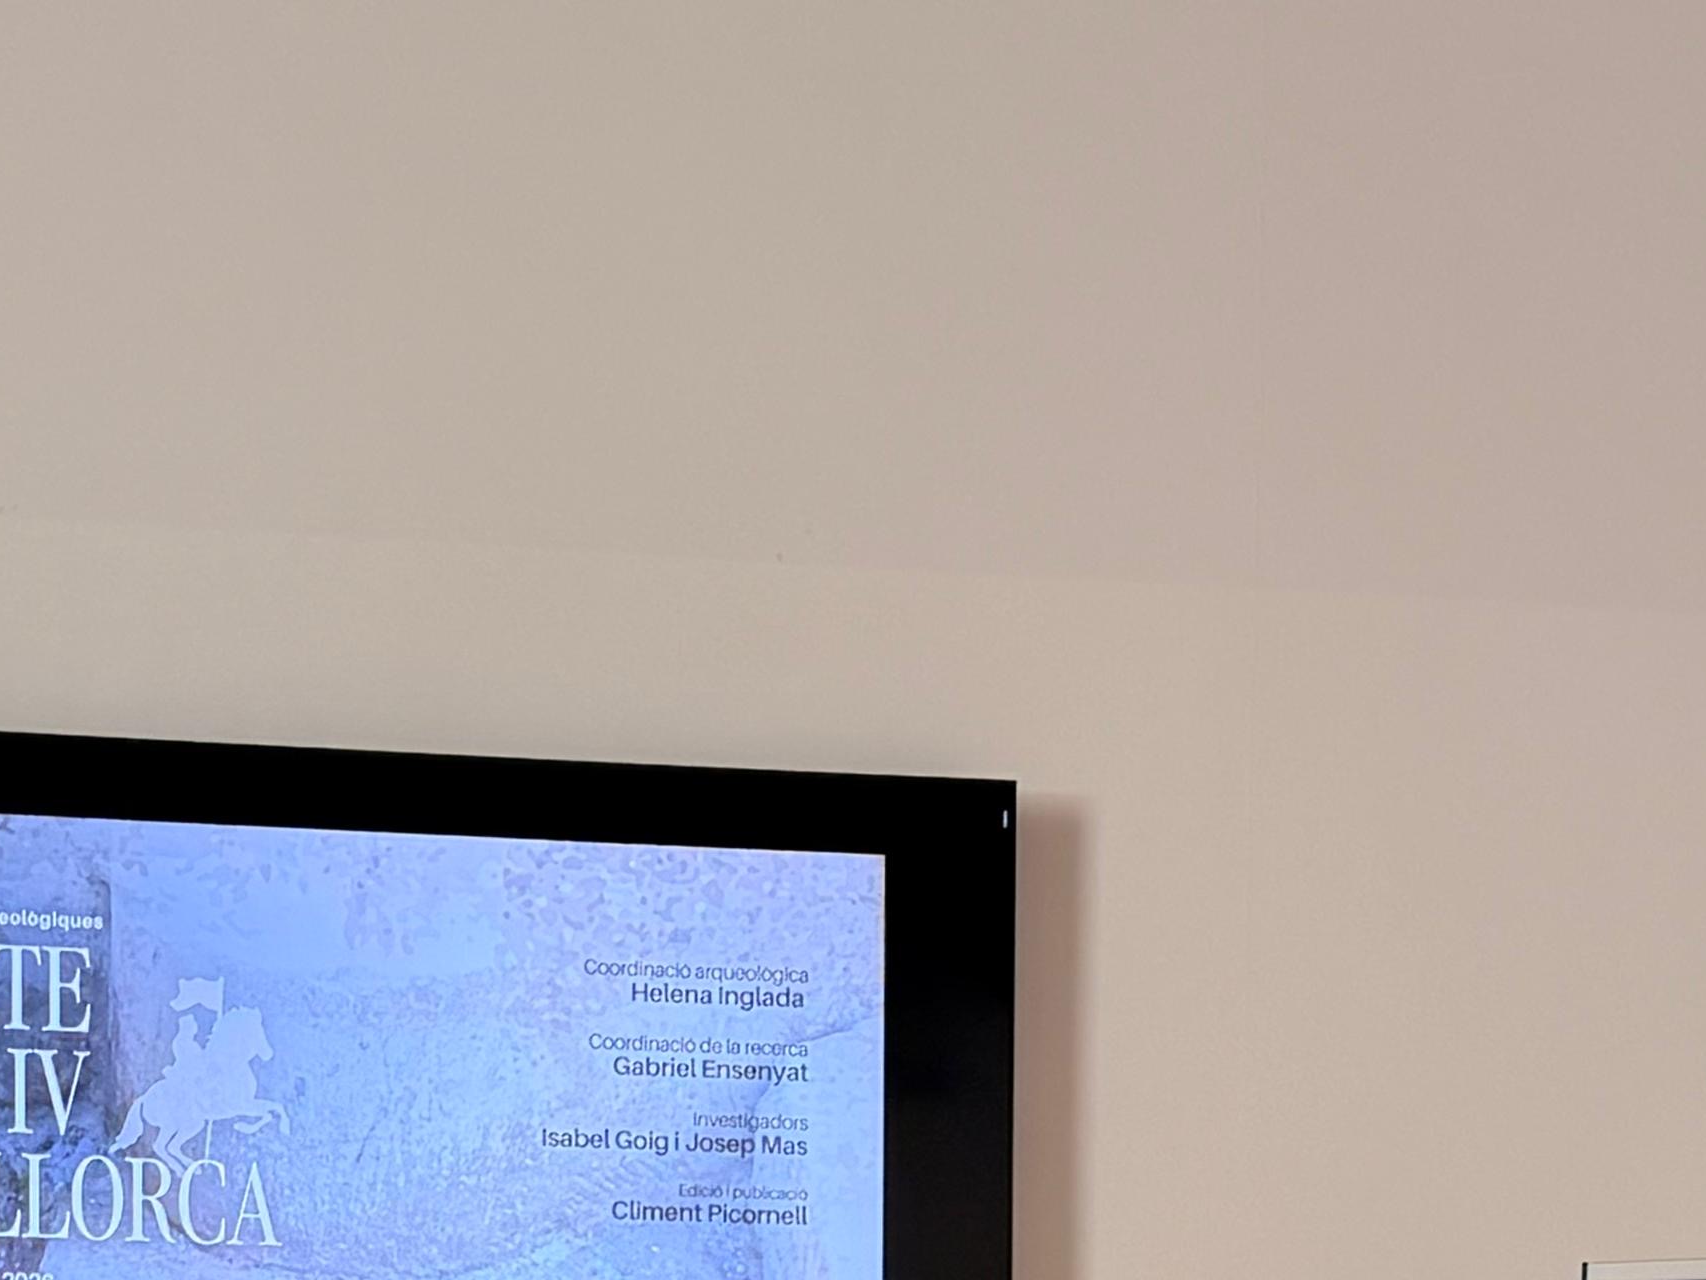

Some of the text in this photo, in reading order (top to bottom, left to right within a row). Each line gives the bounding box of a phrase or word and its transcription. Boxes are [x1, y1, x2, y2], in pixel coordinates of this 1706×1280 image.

[583, 958, 691, 979] Coordinació
[631, 983, 805, 1011] Helena Inglada
[588, 1033, 808, 1057] Coordinació de la recerca
[613, 1056, 808, 1086] Gabriel Ensenyat
[6, 1046, 90, 1136] IV
[693, 1112, 809, 1133] Investigadors
[542, 1128, 610, 1149] Isabel
[615, 1130, 668, 1156] Goig
[685, 1132, 756, 1159] Josep
[761, 1135, 808, 1156] Mas
[679, 1183, 724, 1198] Edició
[611, 1200, 808, 1225] Climent Picornell
